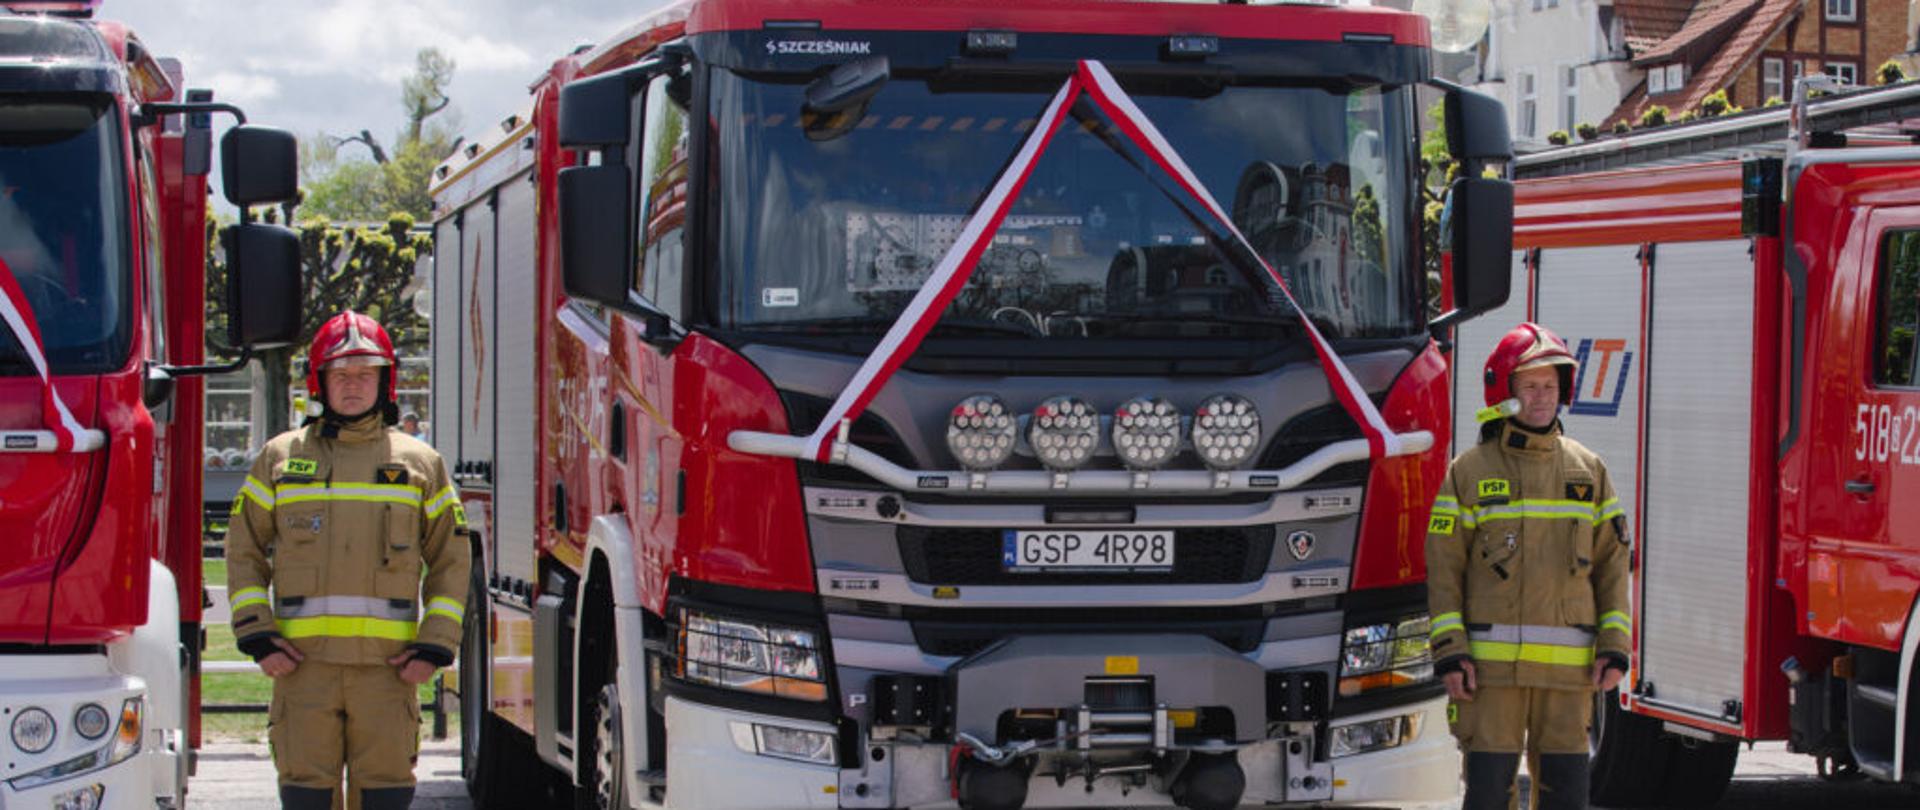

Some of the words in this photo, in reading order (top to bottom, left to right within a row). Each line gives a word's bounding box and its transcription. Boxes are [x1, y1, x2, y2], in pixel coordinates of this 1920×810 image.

[287, 460, 313, 472] PSP
[1482, 481, 1506, 493] PSP
[1431, 517, 1451, 531] PSP
[1023, 533, 1081, 563] GSP
[1094, 533, 1166, 563] 4R98
